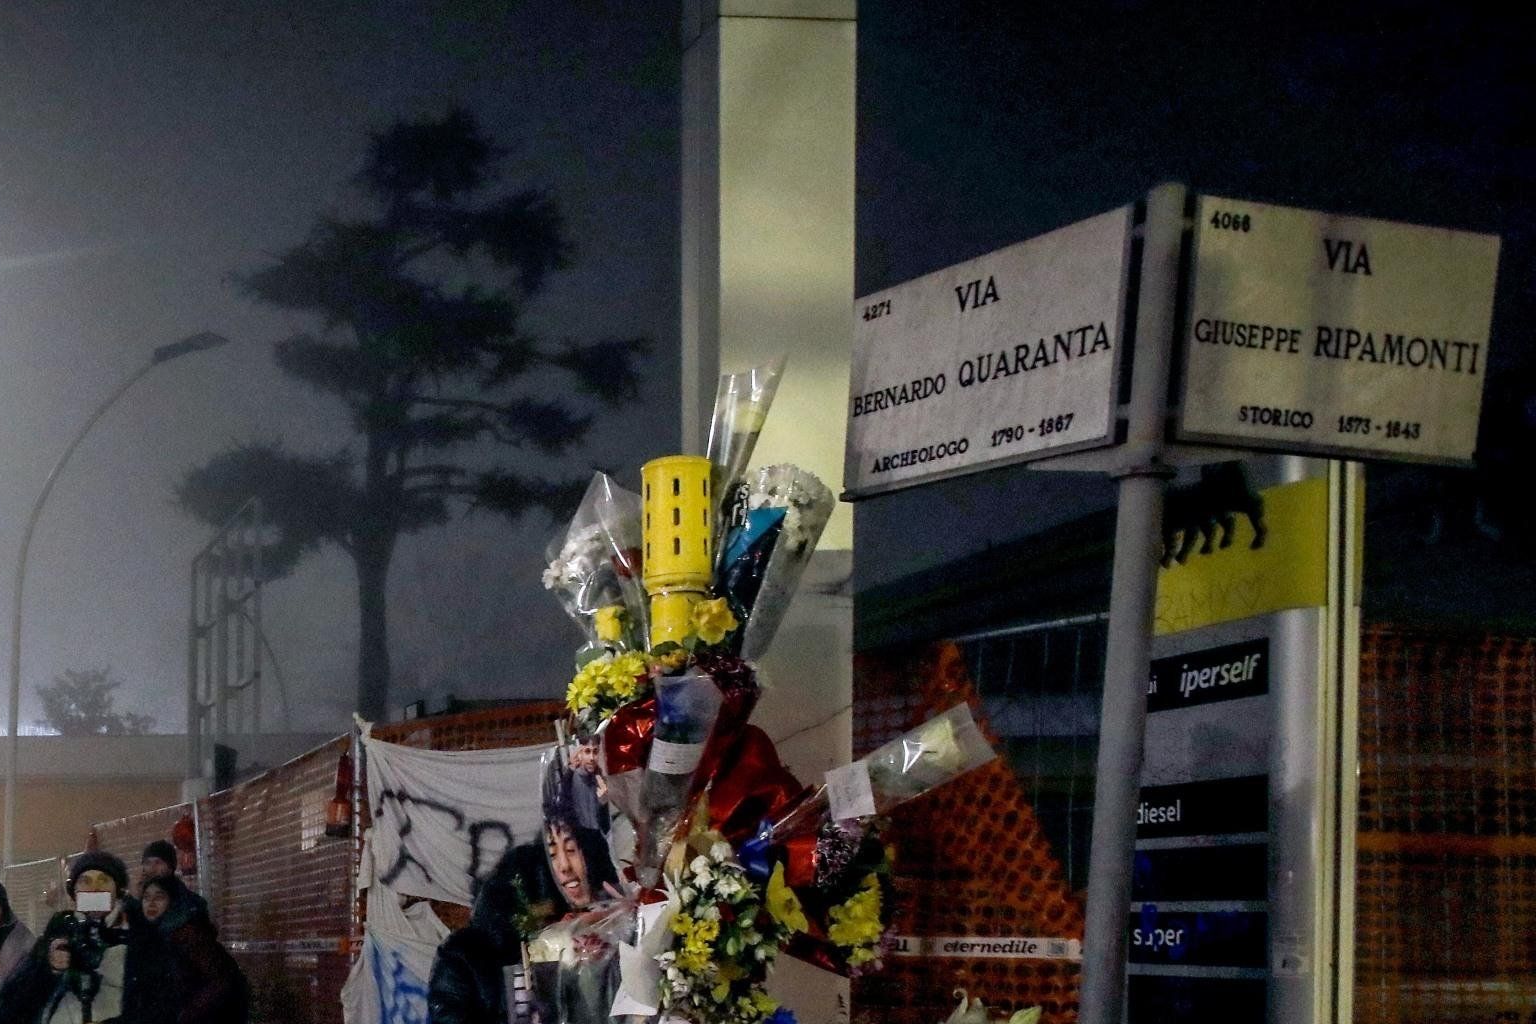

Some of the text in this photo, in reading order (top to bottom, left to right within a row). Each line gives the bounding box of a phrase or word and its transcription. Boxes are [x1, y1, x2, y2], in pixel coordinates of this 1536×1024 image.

[1323, 238, 1372, 276] VIA
[862, 299, 891, 322] 4271
[955, 275, 1000, 313] VIA
[1194, 318, 1480, 375] GIUSEPPE RIPAMONTI
[853, 321, 1111, 418] BERNARDO QUARANTA
[1238, 405, 1313, 430] STORICO
[872, 437, 969, 474] ARCHEOLOGO
[1179, 652, 1261, 698] iperself
